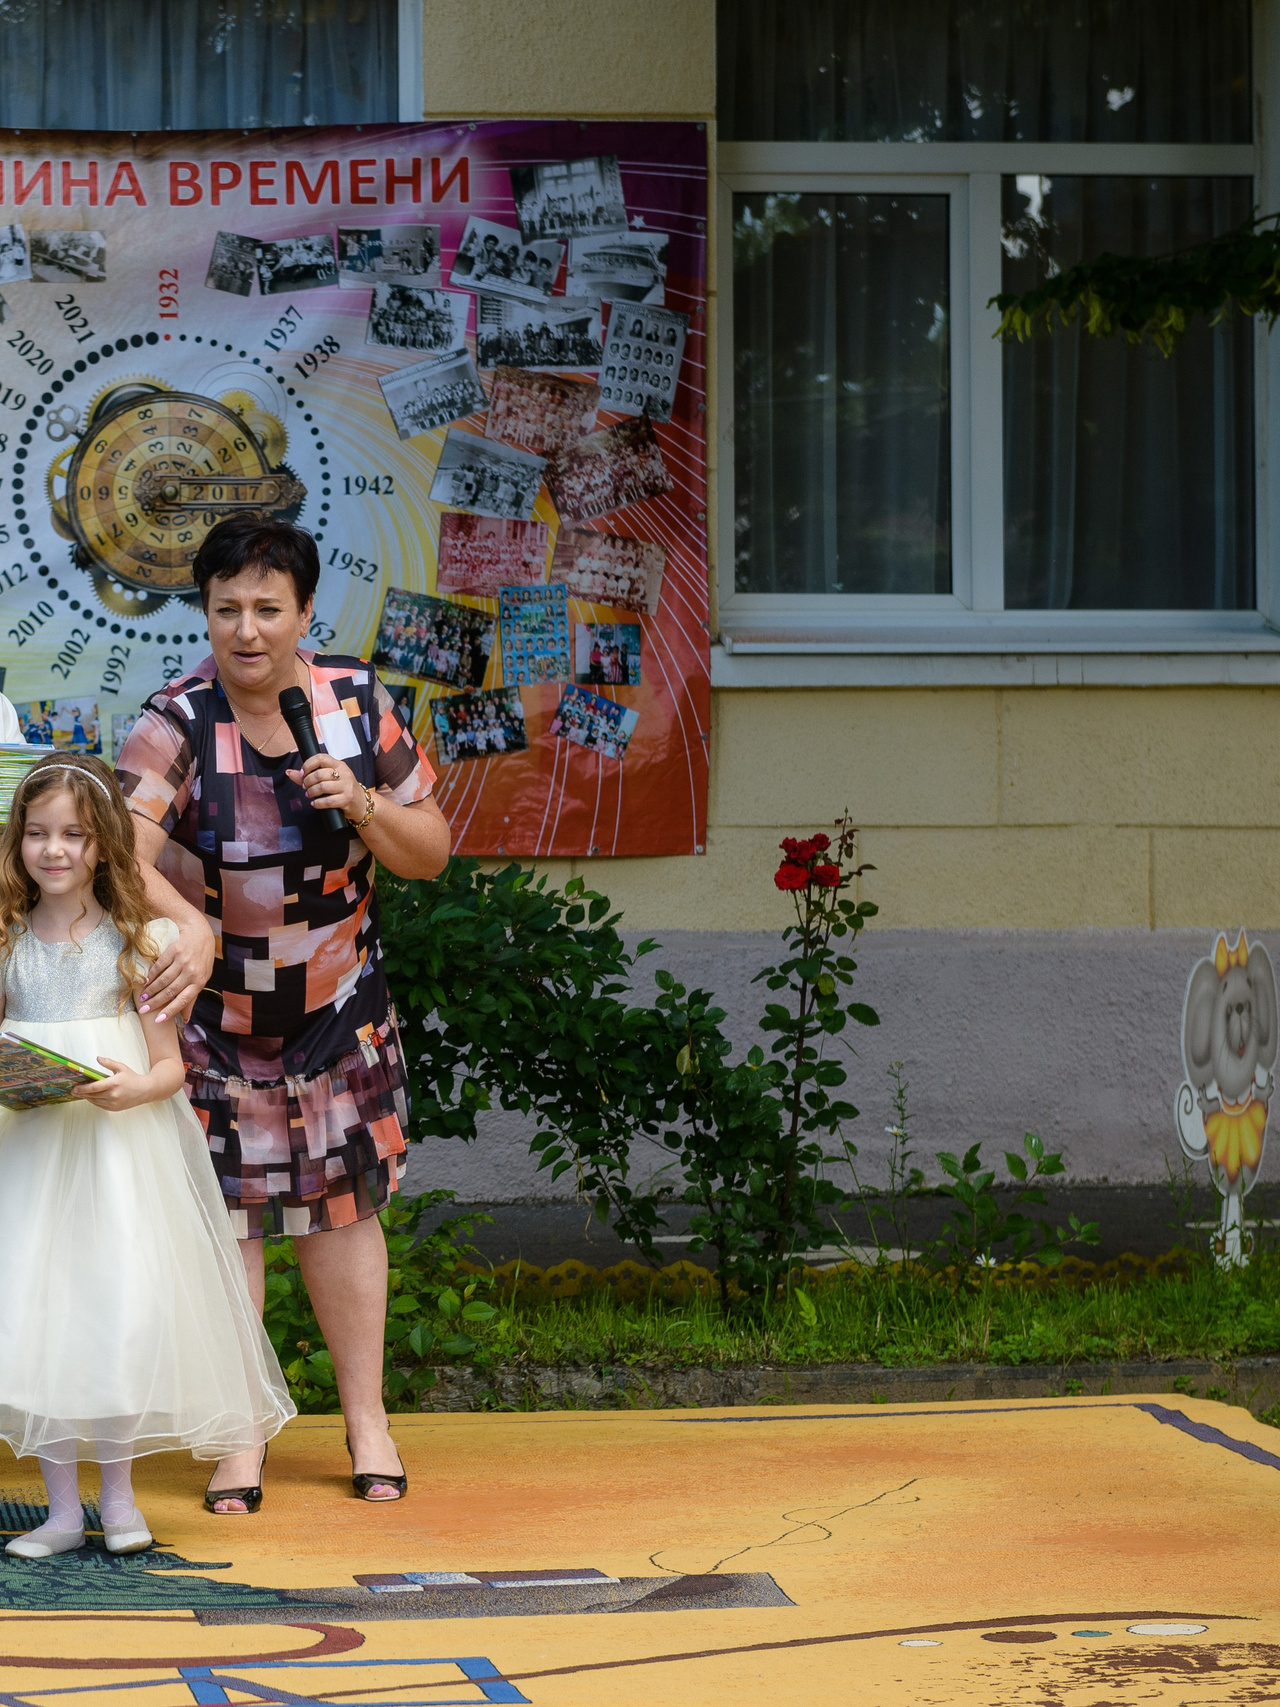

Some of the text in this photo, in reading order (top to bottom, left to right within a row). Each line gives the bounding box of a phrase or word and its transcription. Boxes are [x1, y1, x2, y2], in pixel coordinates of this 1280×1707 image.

[168, 156, 470, 207] ВРЕМЕНИ
[158, 269, 179, 319] 1932
[54, 292, 96, 345] 2021
[264, 304, 304, 354] 1937
[6, 328, 54, 376] 2020
[294, 335, 341, 379] 1938
[342, 474, 395, 496] 1942
[326, 547, 379, 583] 1952
[7, 600, 56, 648] 2010
[308, 611, 337, 648] 62
[50, 627, 92, 680] 2002
[100, 644, 131, 696] 1992
[163, 654, 183, 682] 82
